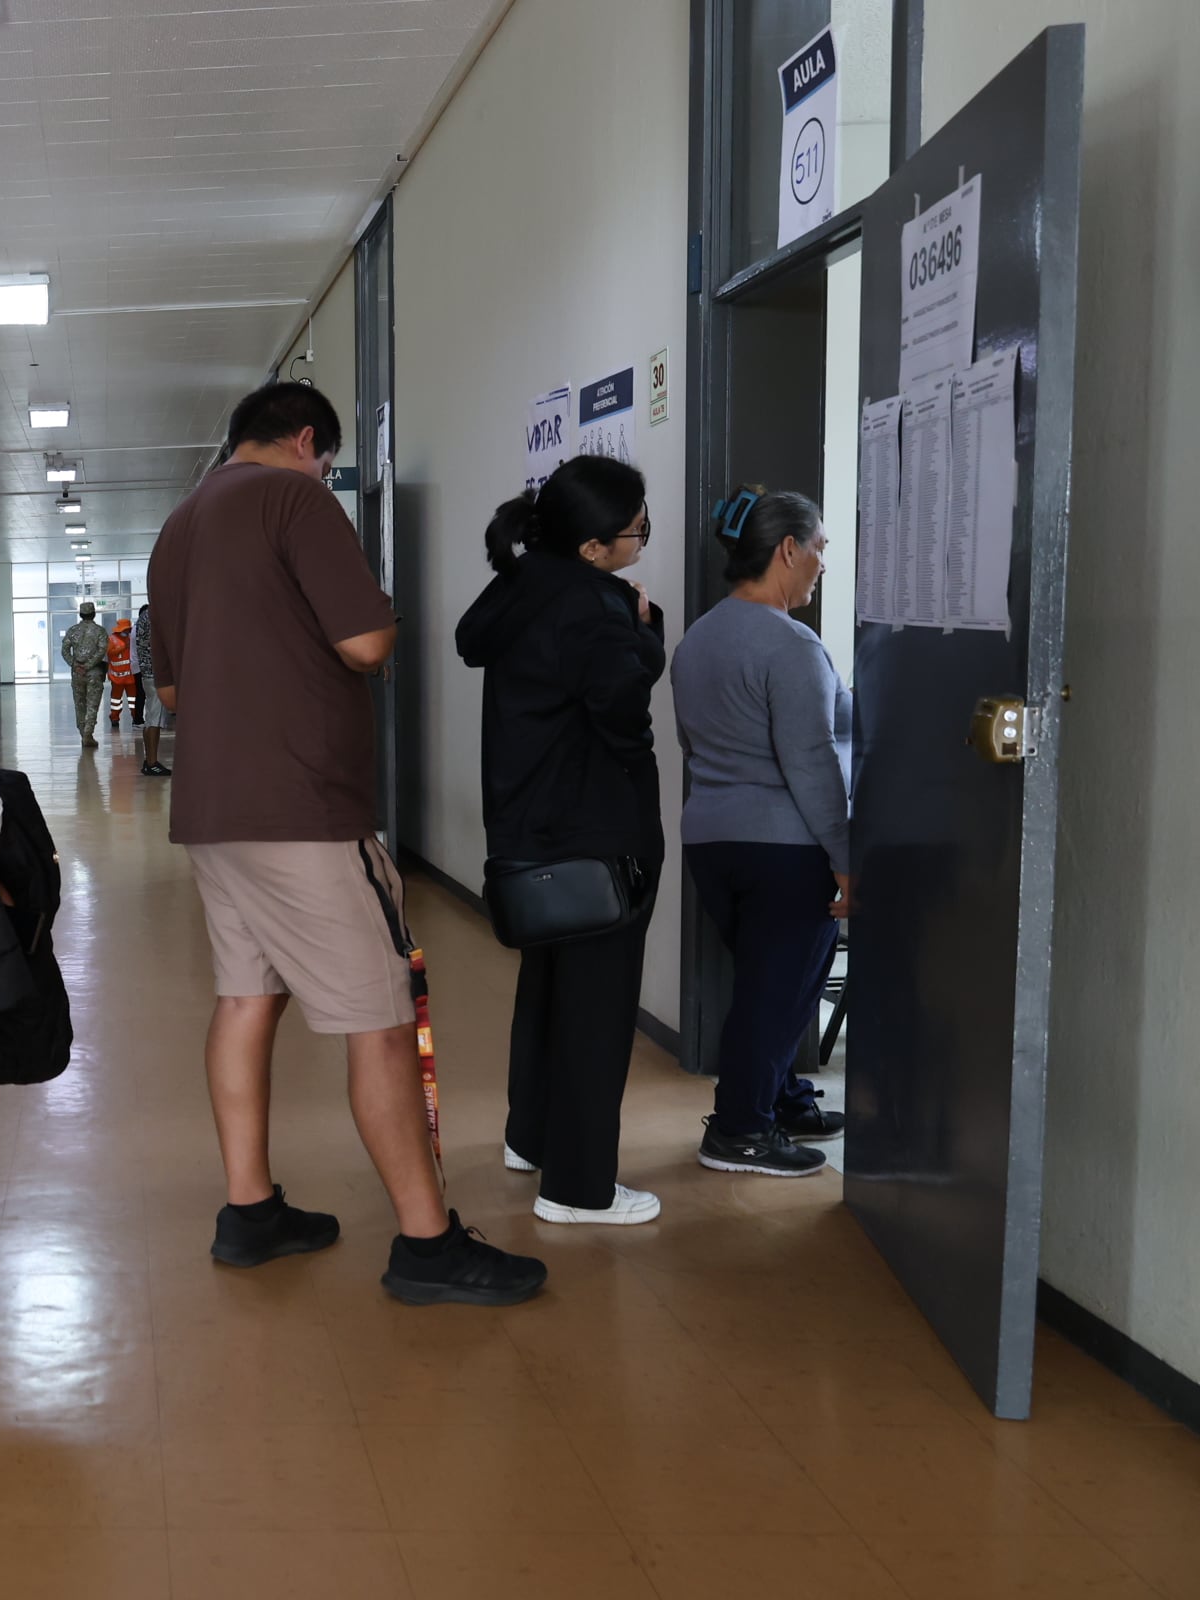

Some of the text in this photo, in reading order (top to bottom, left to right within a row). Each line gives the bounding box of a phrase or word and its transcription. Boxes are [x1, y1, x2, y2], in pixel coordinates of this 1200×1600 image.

[793, 49, 826, 92] AULA
[795, 141, 819, 185] 511
[909, 224, 962, 290] 036496
[653, 363, 665, 389] 30
[526, 414, 563, 454] VOTAR
[323, 469, 342, 479] LA
